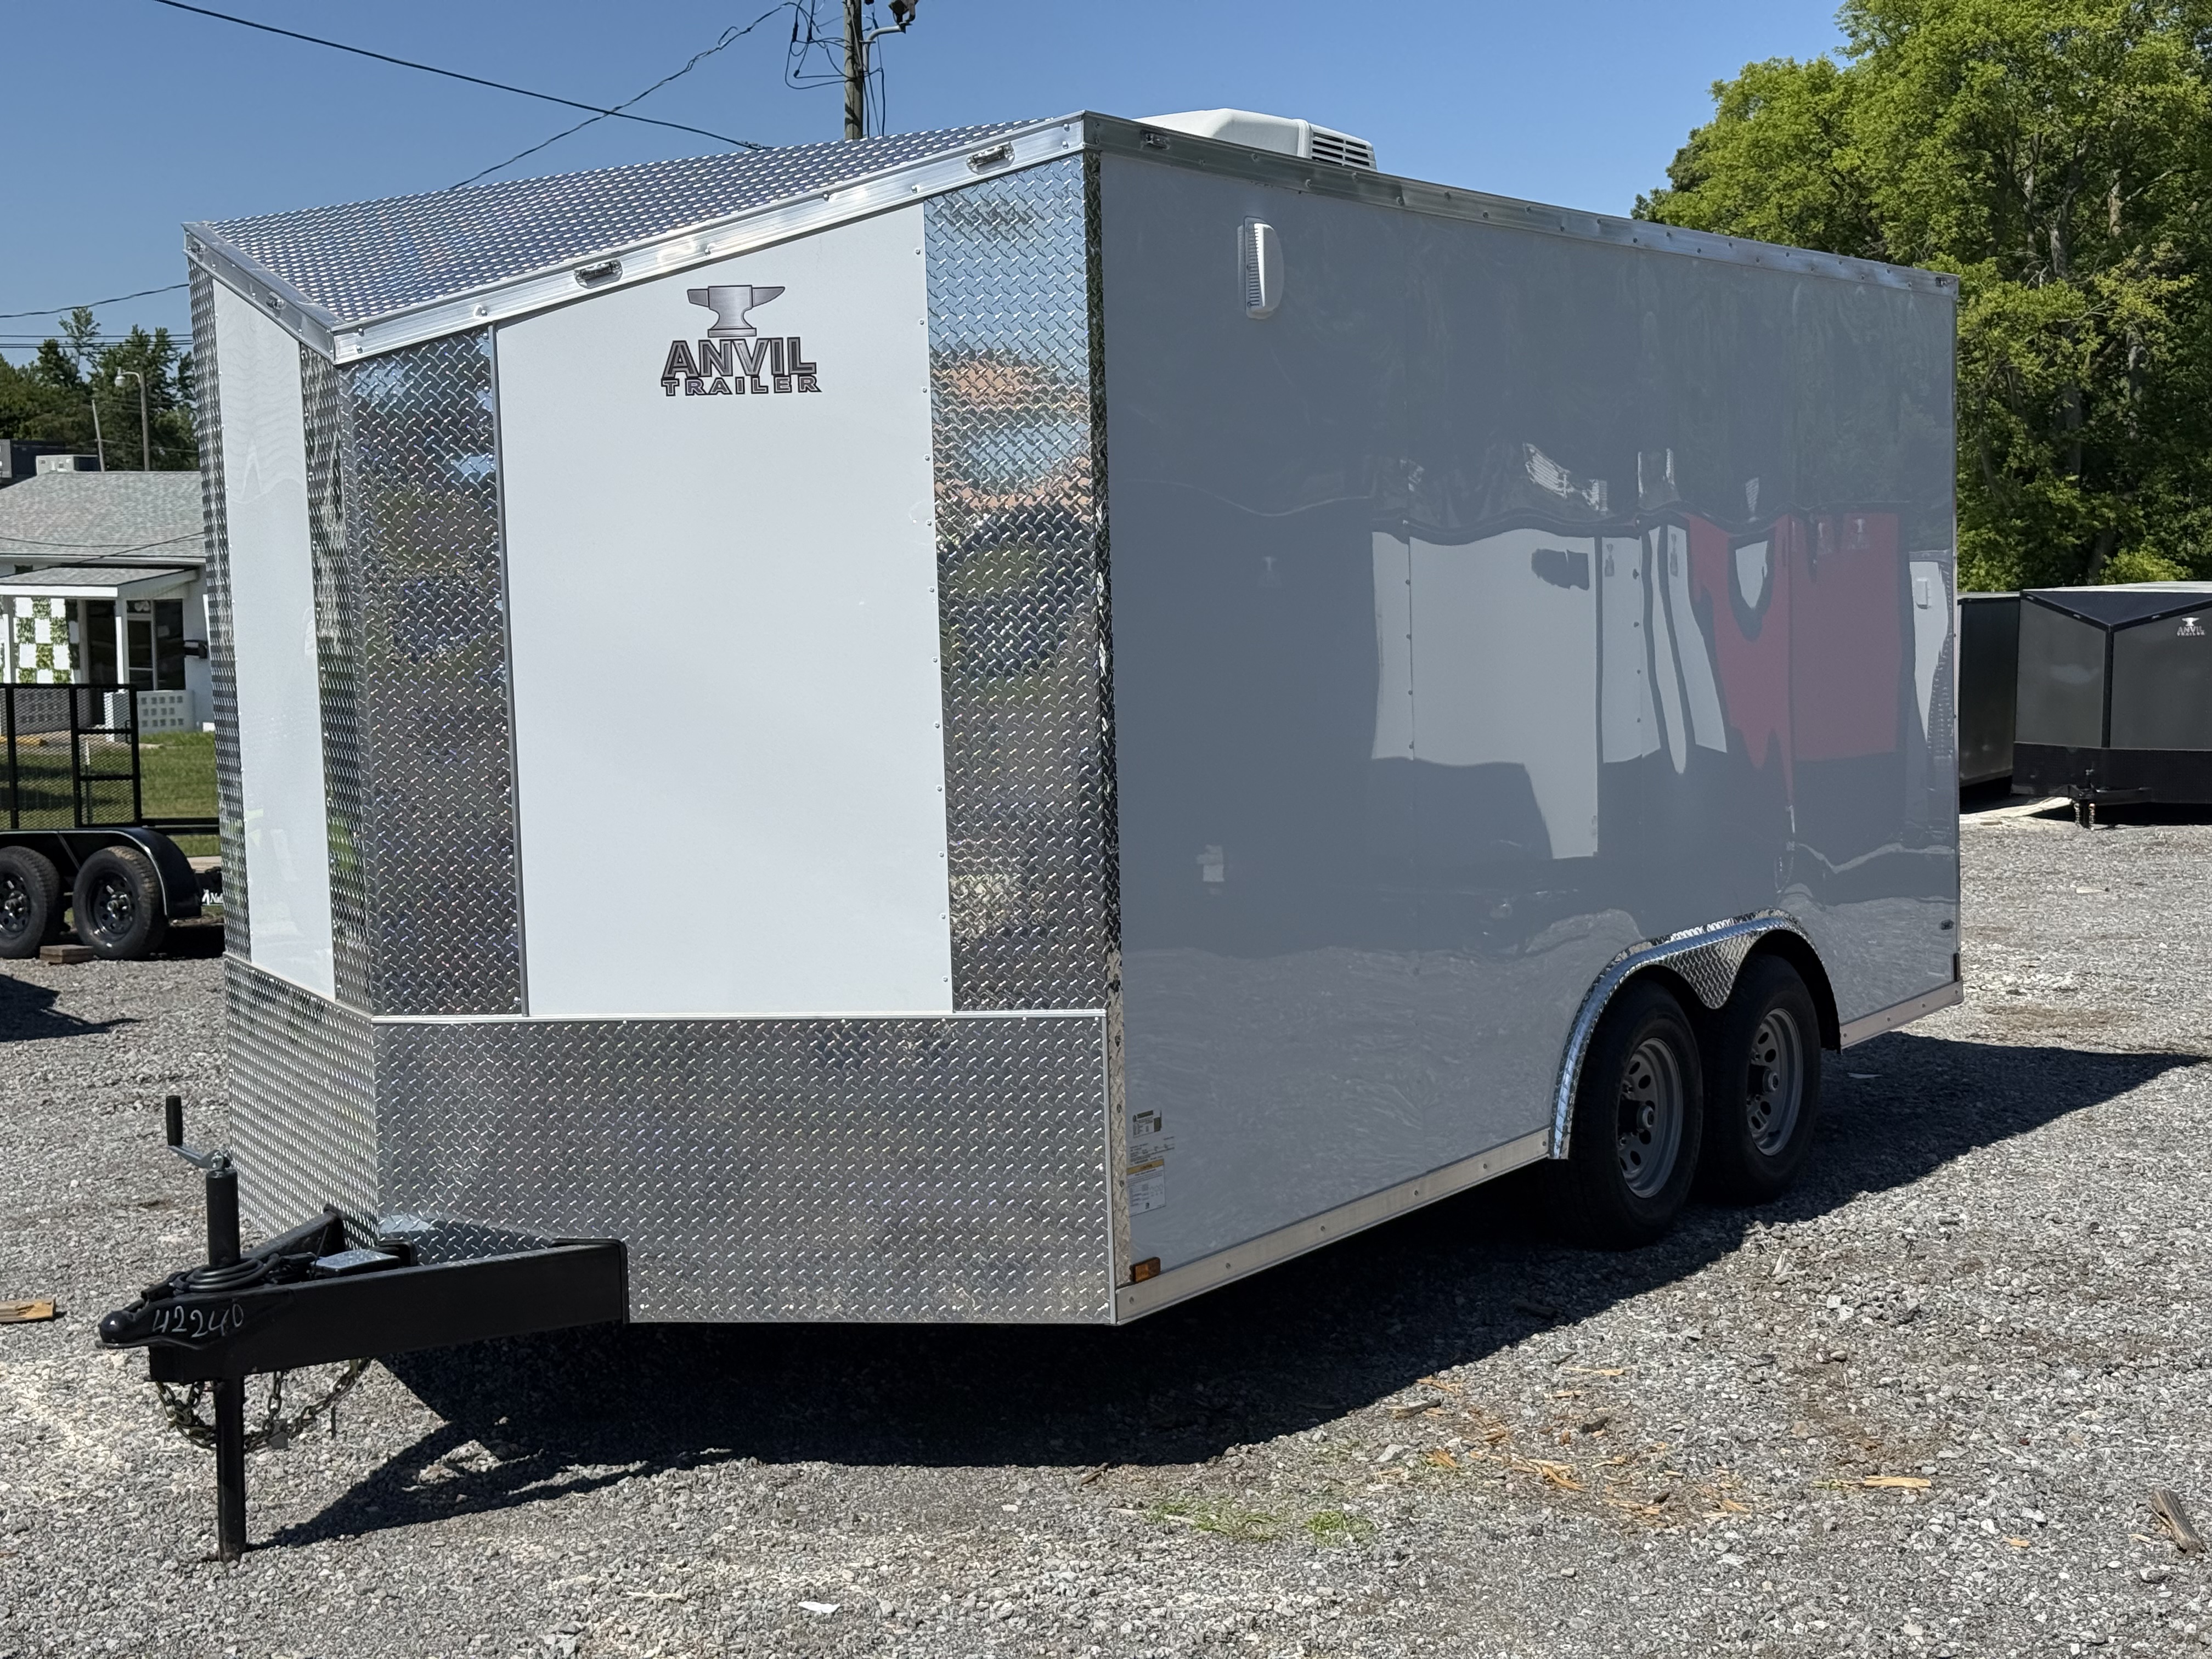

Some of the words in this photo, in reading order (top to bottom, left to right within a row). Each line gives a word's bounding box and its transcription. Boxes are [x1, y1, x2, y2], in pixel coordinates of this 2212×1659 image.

[662, 337, 817, 379] ANVIL
[661, 375, 822, 396] TRAILER
[152, 1303, 244, 1338] 42240
